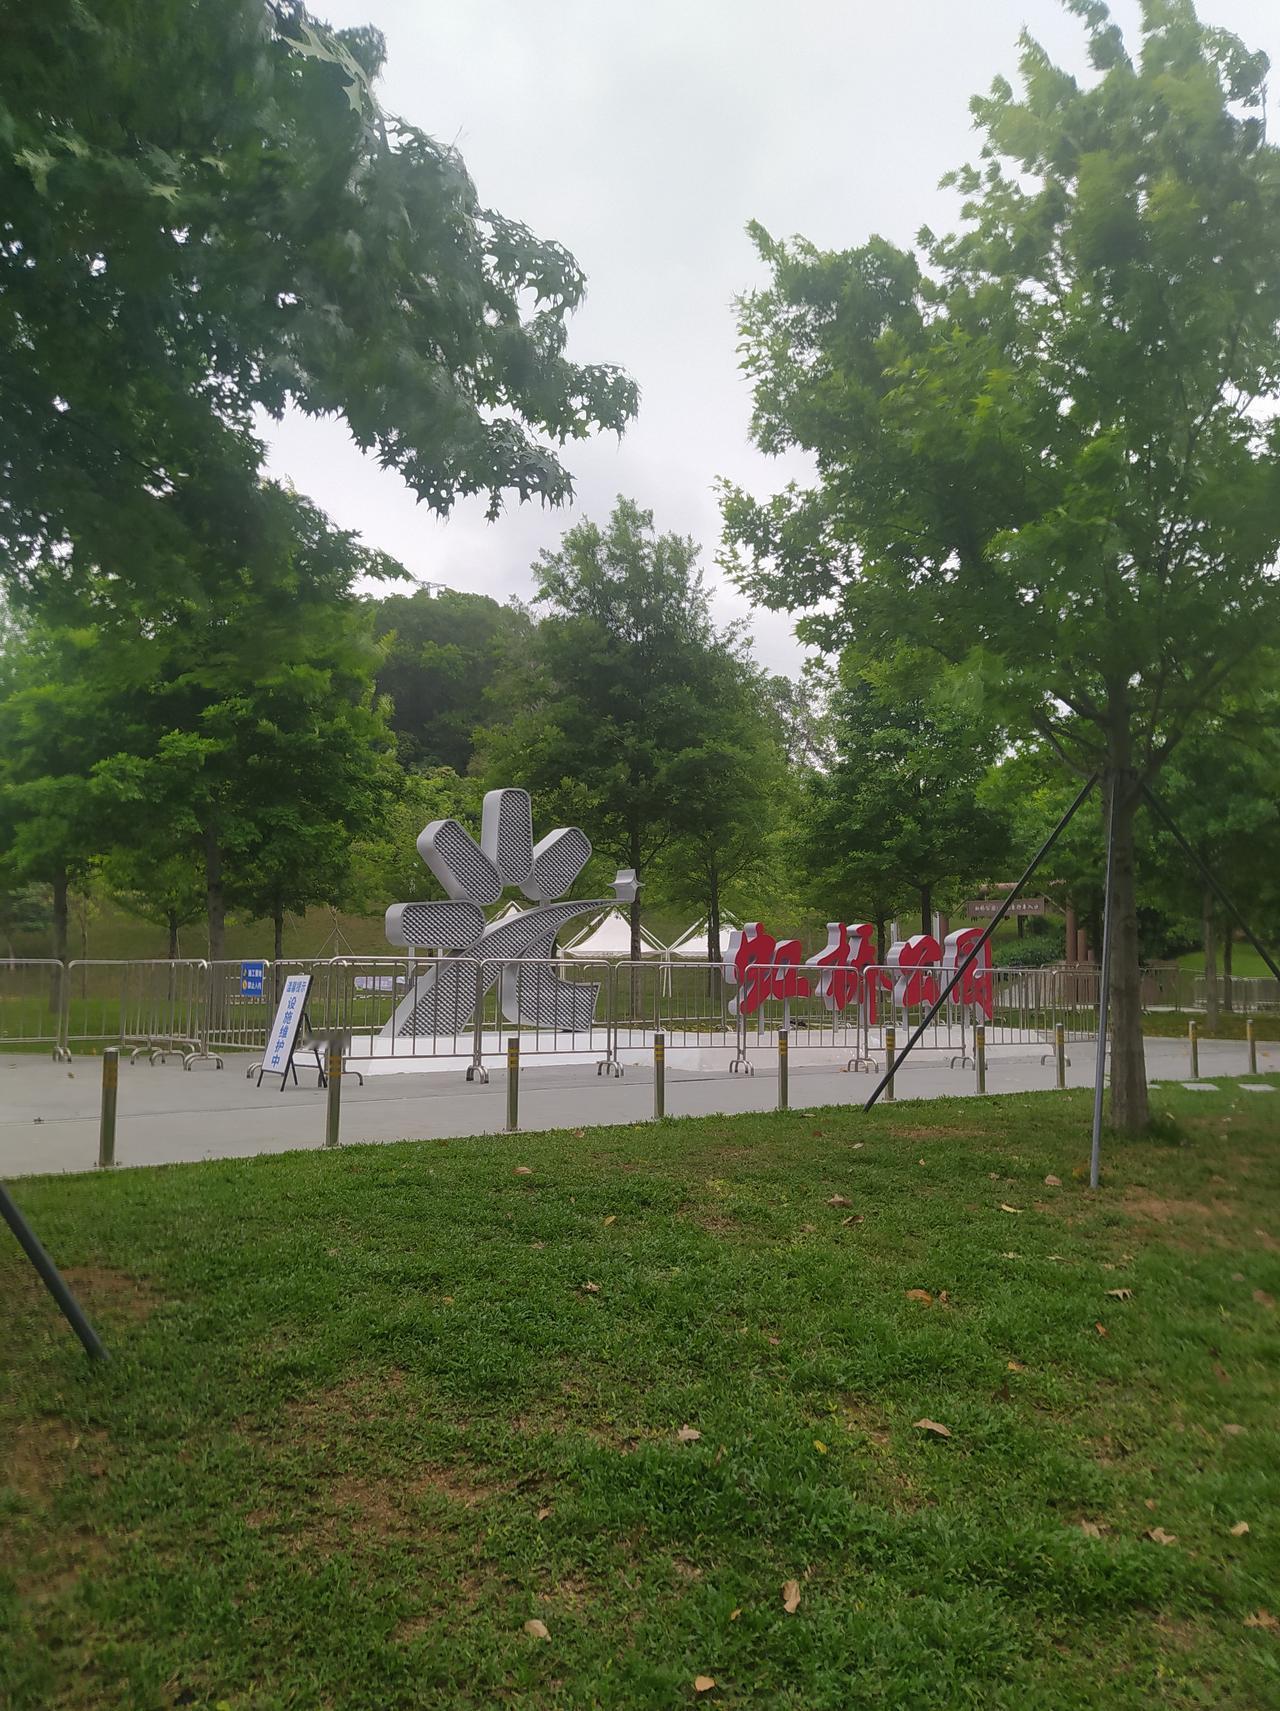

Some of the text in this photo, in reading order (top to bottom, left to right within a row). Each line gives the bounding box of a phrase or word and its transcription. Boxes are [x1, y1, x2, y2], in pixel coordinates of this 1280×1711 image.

[286, 981, 307, 993] 温馨提示
[271, 996, 297, 1069] 设施维护中
